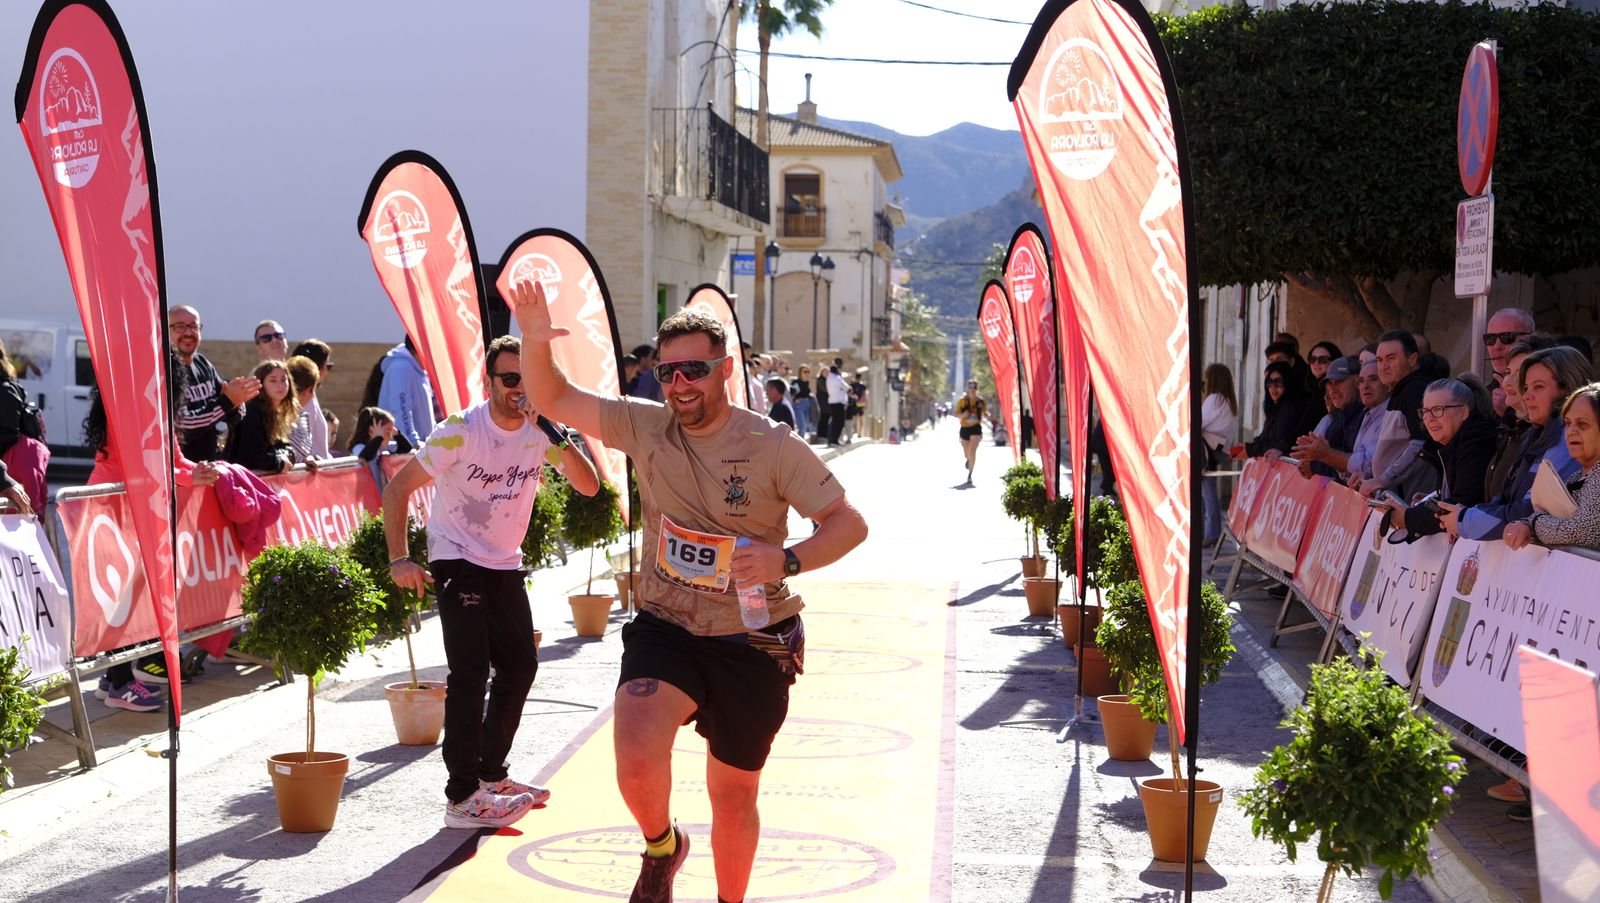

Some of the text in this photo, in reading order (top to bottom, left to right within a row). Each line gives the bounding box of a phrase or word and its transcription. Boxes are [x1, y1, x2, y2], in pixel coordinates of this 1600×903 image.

[1467, 200, 1488, 217] PROHIBIDO
[1461, 245, 1471, 257] TODA
[1476, 243, 1487, 255] PLAZA
[467, 463, 540, 489] Pepe Yepes
[488, 490, 521, 504] speaker
[304, 501, 364, 550] VEOLI
[668, 537, 716, 567] 169
[1482, 585, 1600, 651] AYUNTAMIENT
